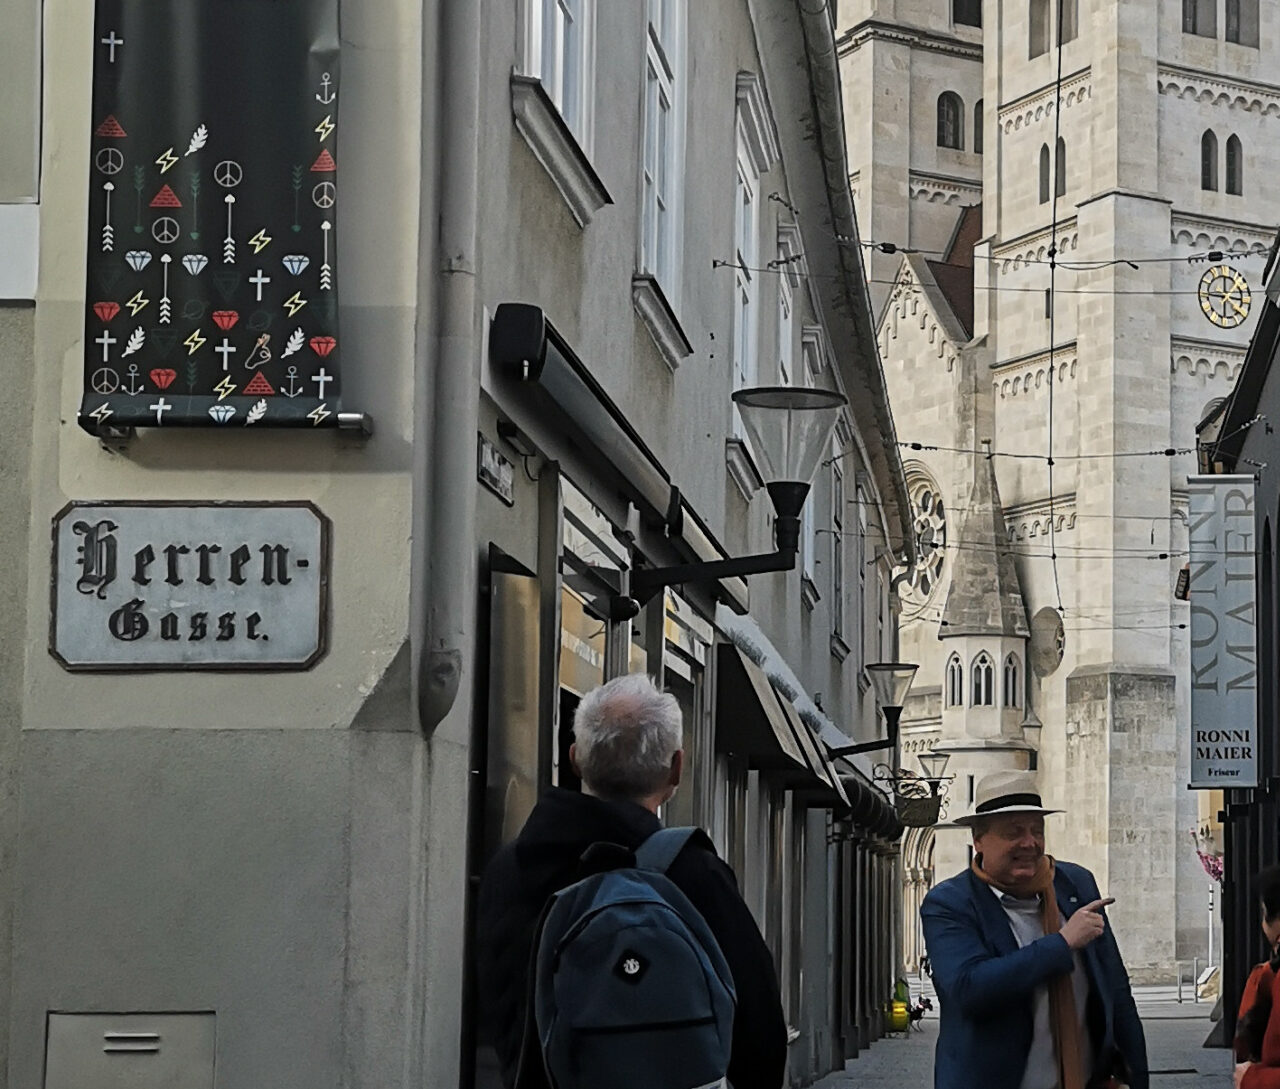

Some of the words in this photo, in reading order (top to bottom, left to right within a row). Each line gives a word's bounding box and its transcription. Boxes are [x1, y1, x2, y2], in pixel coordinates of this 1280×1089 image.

[1190, 486, 1218, 695] RONNI
[1224, 489, 1254, 695] MAIER
[1195, 747, 1252, 760] MAIER
[1196, 730, 1250, 743] RONNI
